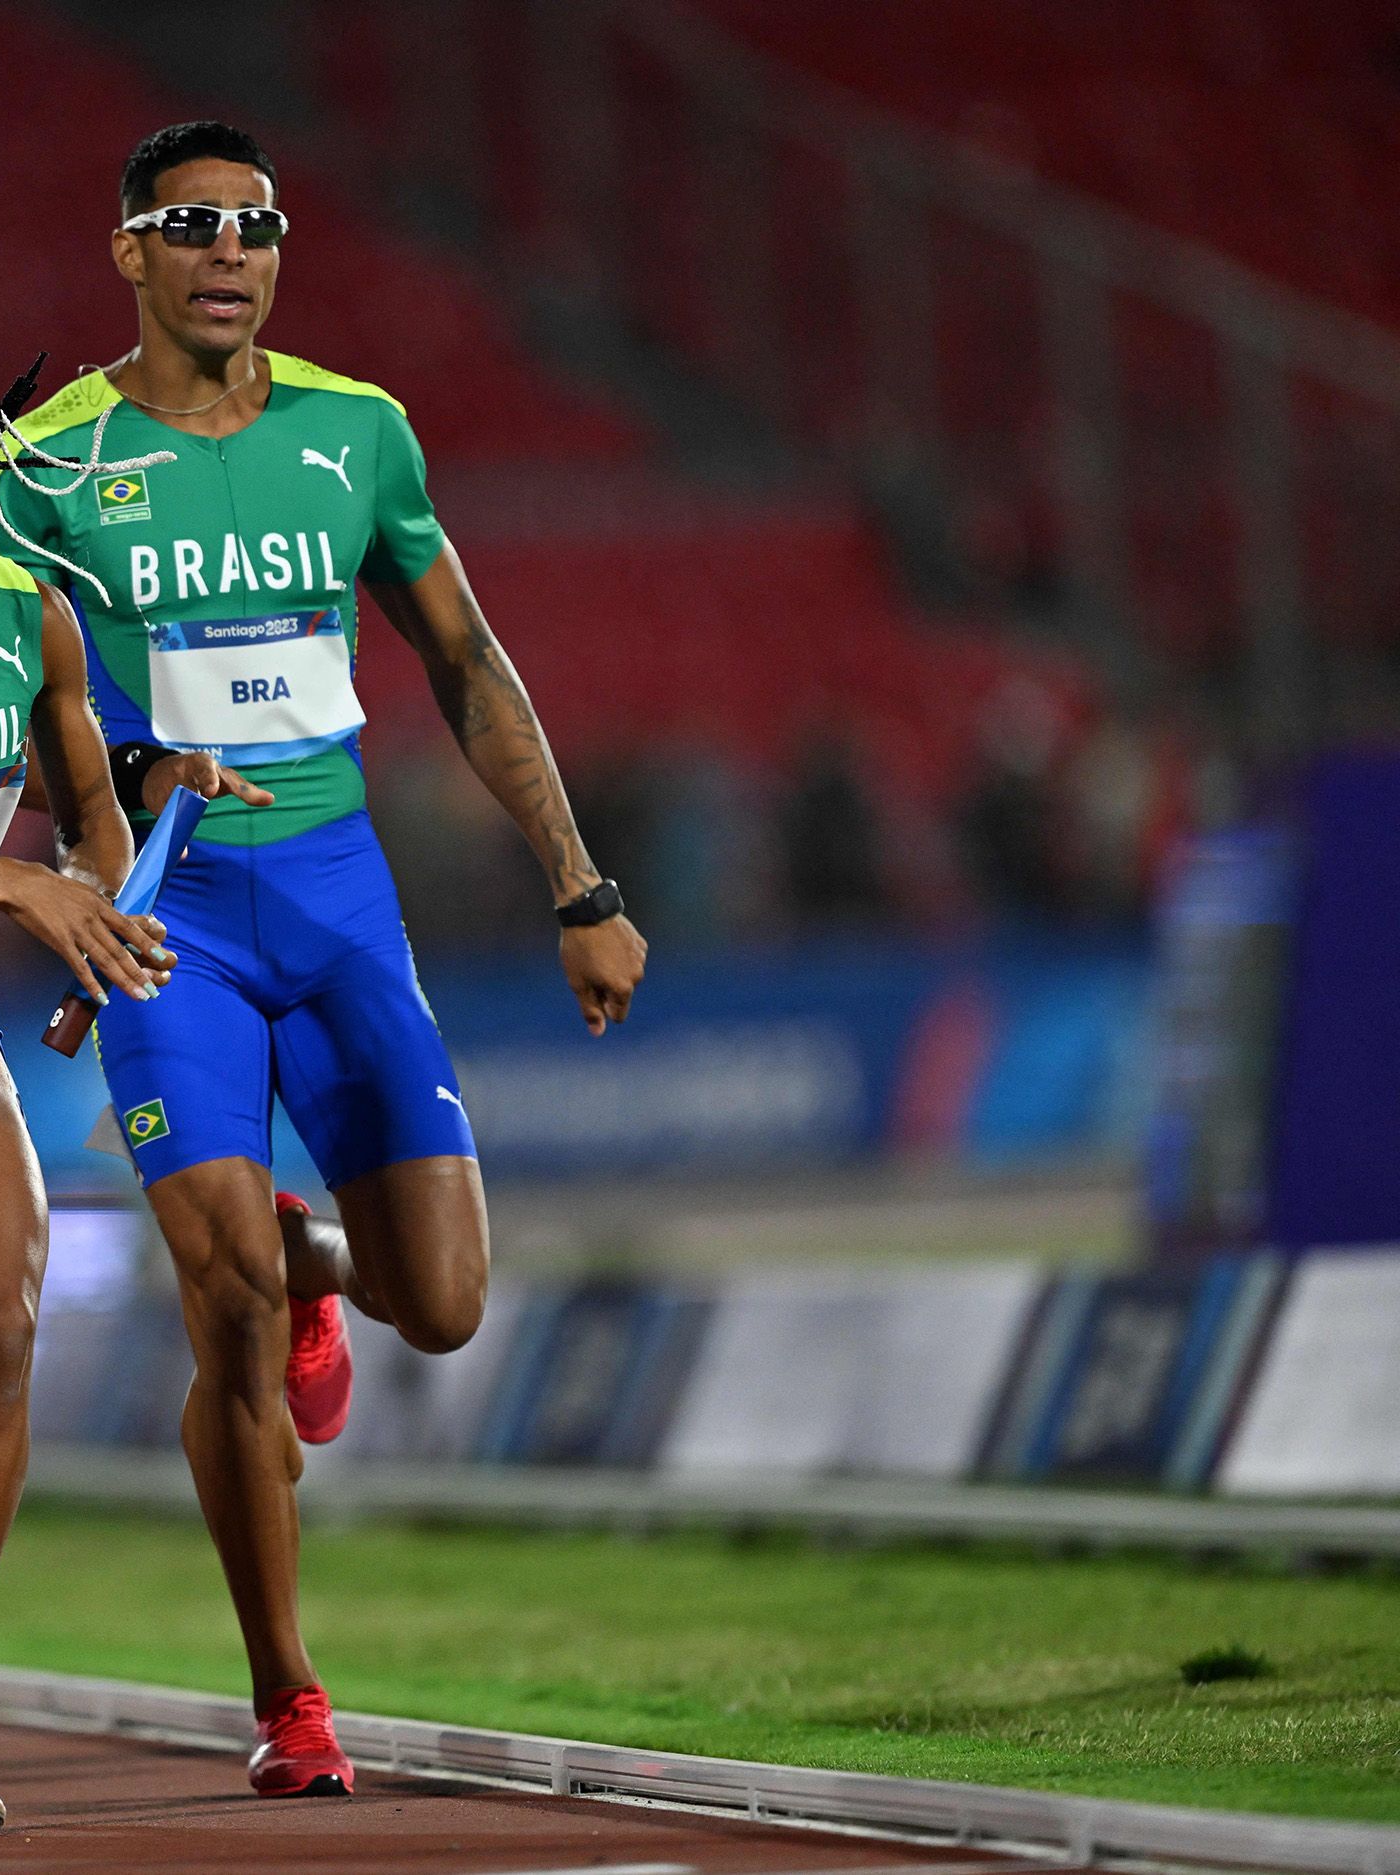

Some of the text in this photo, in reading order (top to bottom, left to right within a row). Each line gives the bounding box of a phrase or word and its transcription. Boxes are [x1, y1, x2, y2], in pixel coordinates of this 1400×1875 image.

[130, 531, 346, 606] BRASIL
[231, 676, 292, 704] BRA
[50, 1008, 65, 1028] 8
